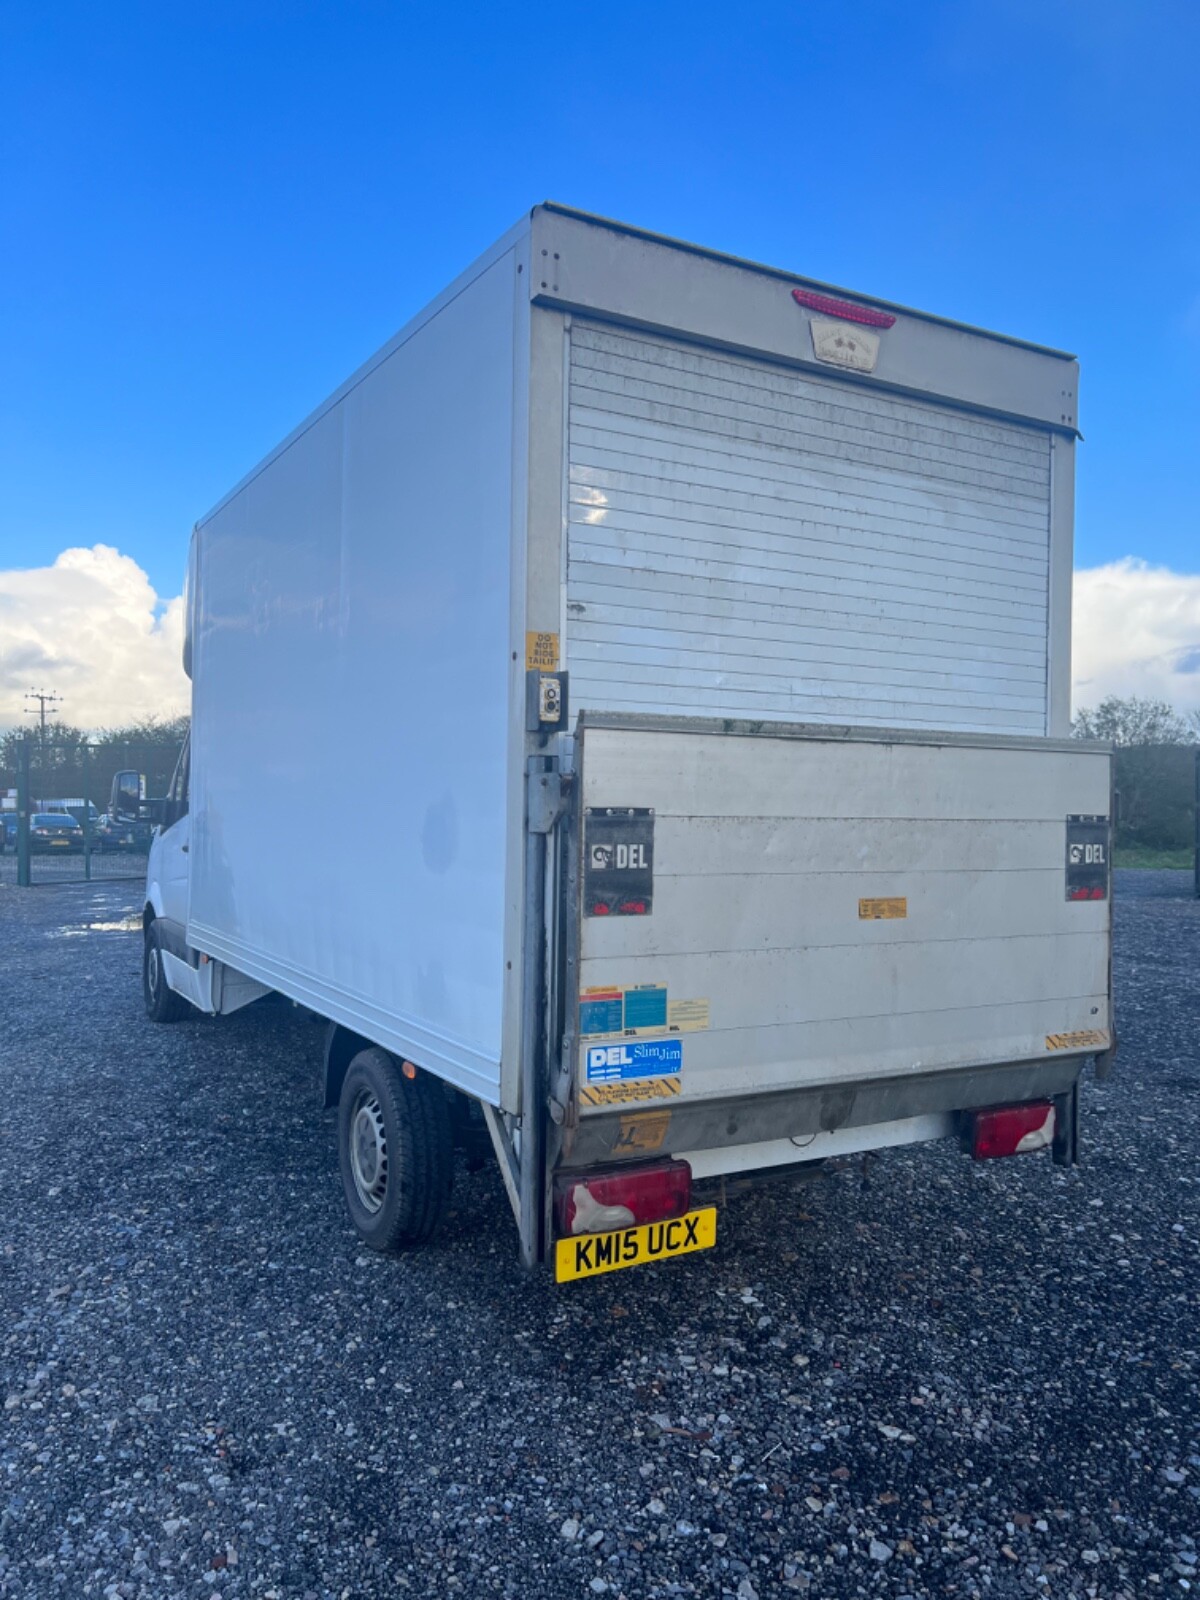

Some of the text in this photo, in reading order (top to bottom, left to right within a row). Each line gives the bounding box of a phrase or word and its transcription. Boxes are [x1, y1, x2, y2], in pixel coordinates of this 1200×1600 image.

[538, 634, 551, 642] DO
[534, 649, 554, 657] RIDE
[616, 844, 648, 869] DEL
[1085, 844, 1105, 864] DEL
[590, 1044, 680, 1067] DEL Slim Jim
[575, 1217, 699, 1272] KM15 UCX
